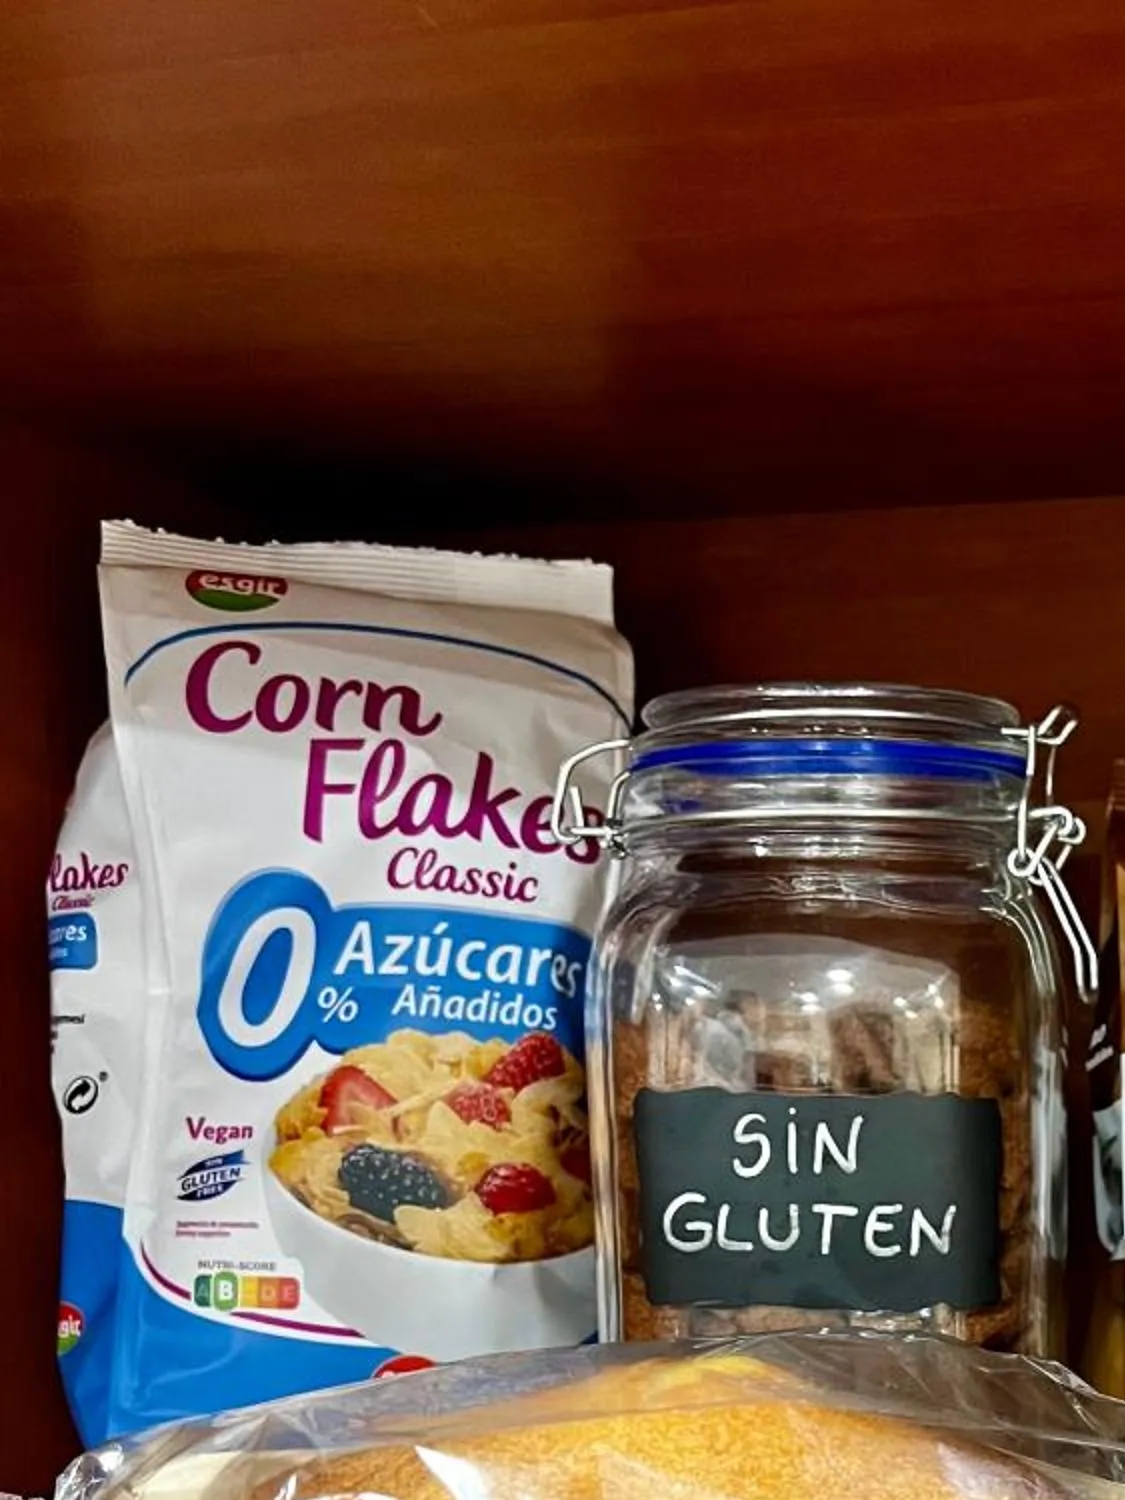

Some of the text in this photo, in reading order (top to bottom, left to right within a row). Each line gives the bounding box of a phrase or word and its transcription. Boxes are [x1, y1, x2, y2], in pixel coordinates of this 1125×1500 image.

[198, 571, 287, 598] esgir
[185, 640, 443, 737] Corn
[302, 738, 607, 866] Flakes
[49, 852, 130, 893] lakes
[387, 846, 539, 904] Classic
[333, 921, 583, 999] Azúcares
[390, 983, 558, 1031] Añadidos
[185, 1116, 254, 1144] Vegan
[181, 1167, 241, 1192] GLUTEN
[663, 1191, 958, 1258] GLUTEN
